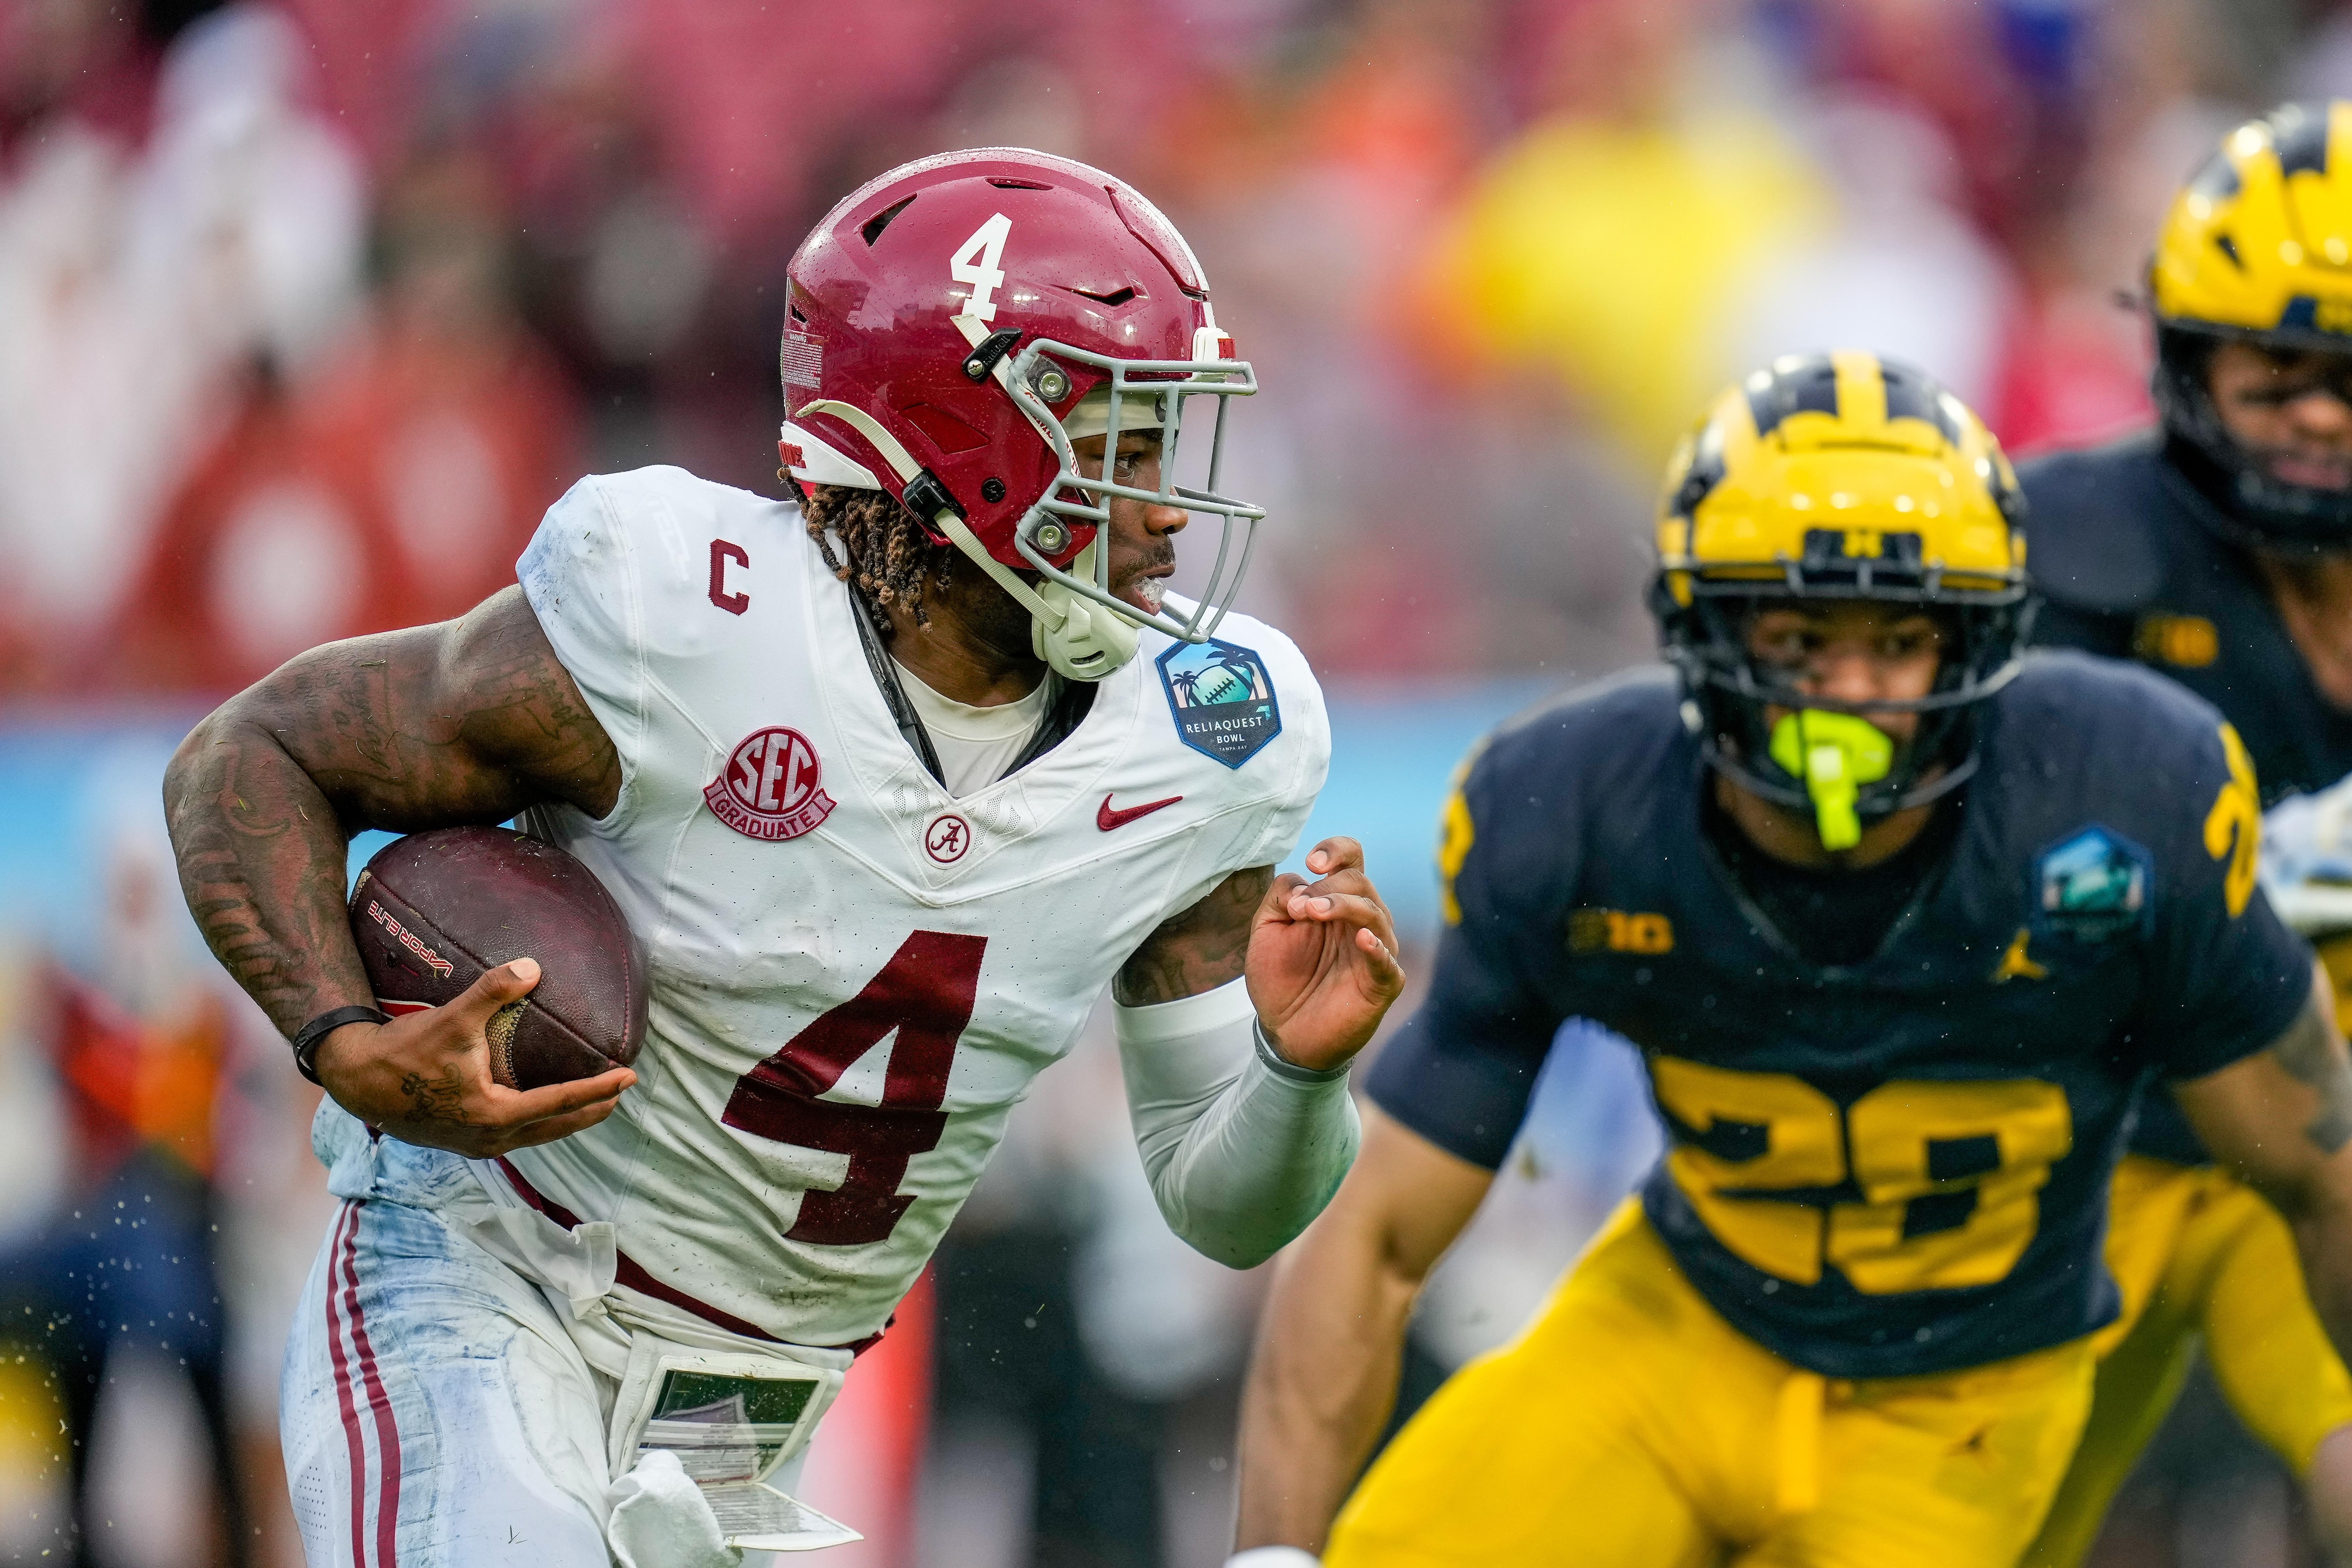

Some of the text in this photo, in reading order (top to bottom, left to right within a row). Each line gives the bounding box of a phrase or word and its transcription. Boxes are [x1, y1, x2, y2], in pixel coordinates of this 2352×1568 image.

[950, 212, 1013, 321] 4
[789, 333, 807, 342] WARNING
[708, 538, 750, 616] C
[1186, 716, 1263, 733] RELIAQUEST
[1216, 733, 1245, 744] BOWL
[732, 733, 813, 811] SEC
[715, 799, 816, 837] GRADUATE
[930, 822, 961, 852] A
[367, 899, 454, 978] VAPOR ELITE
[720, 929, 988, 1246] 4
